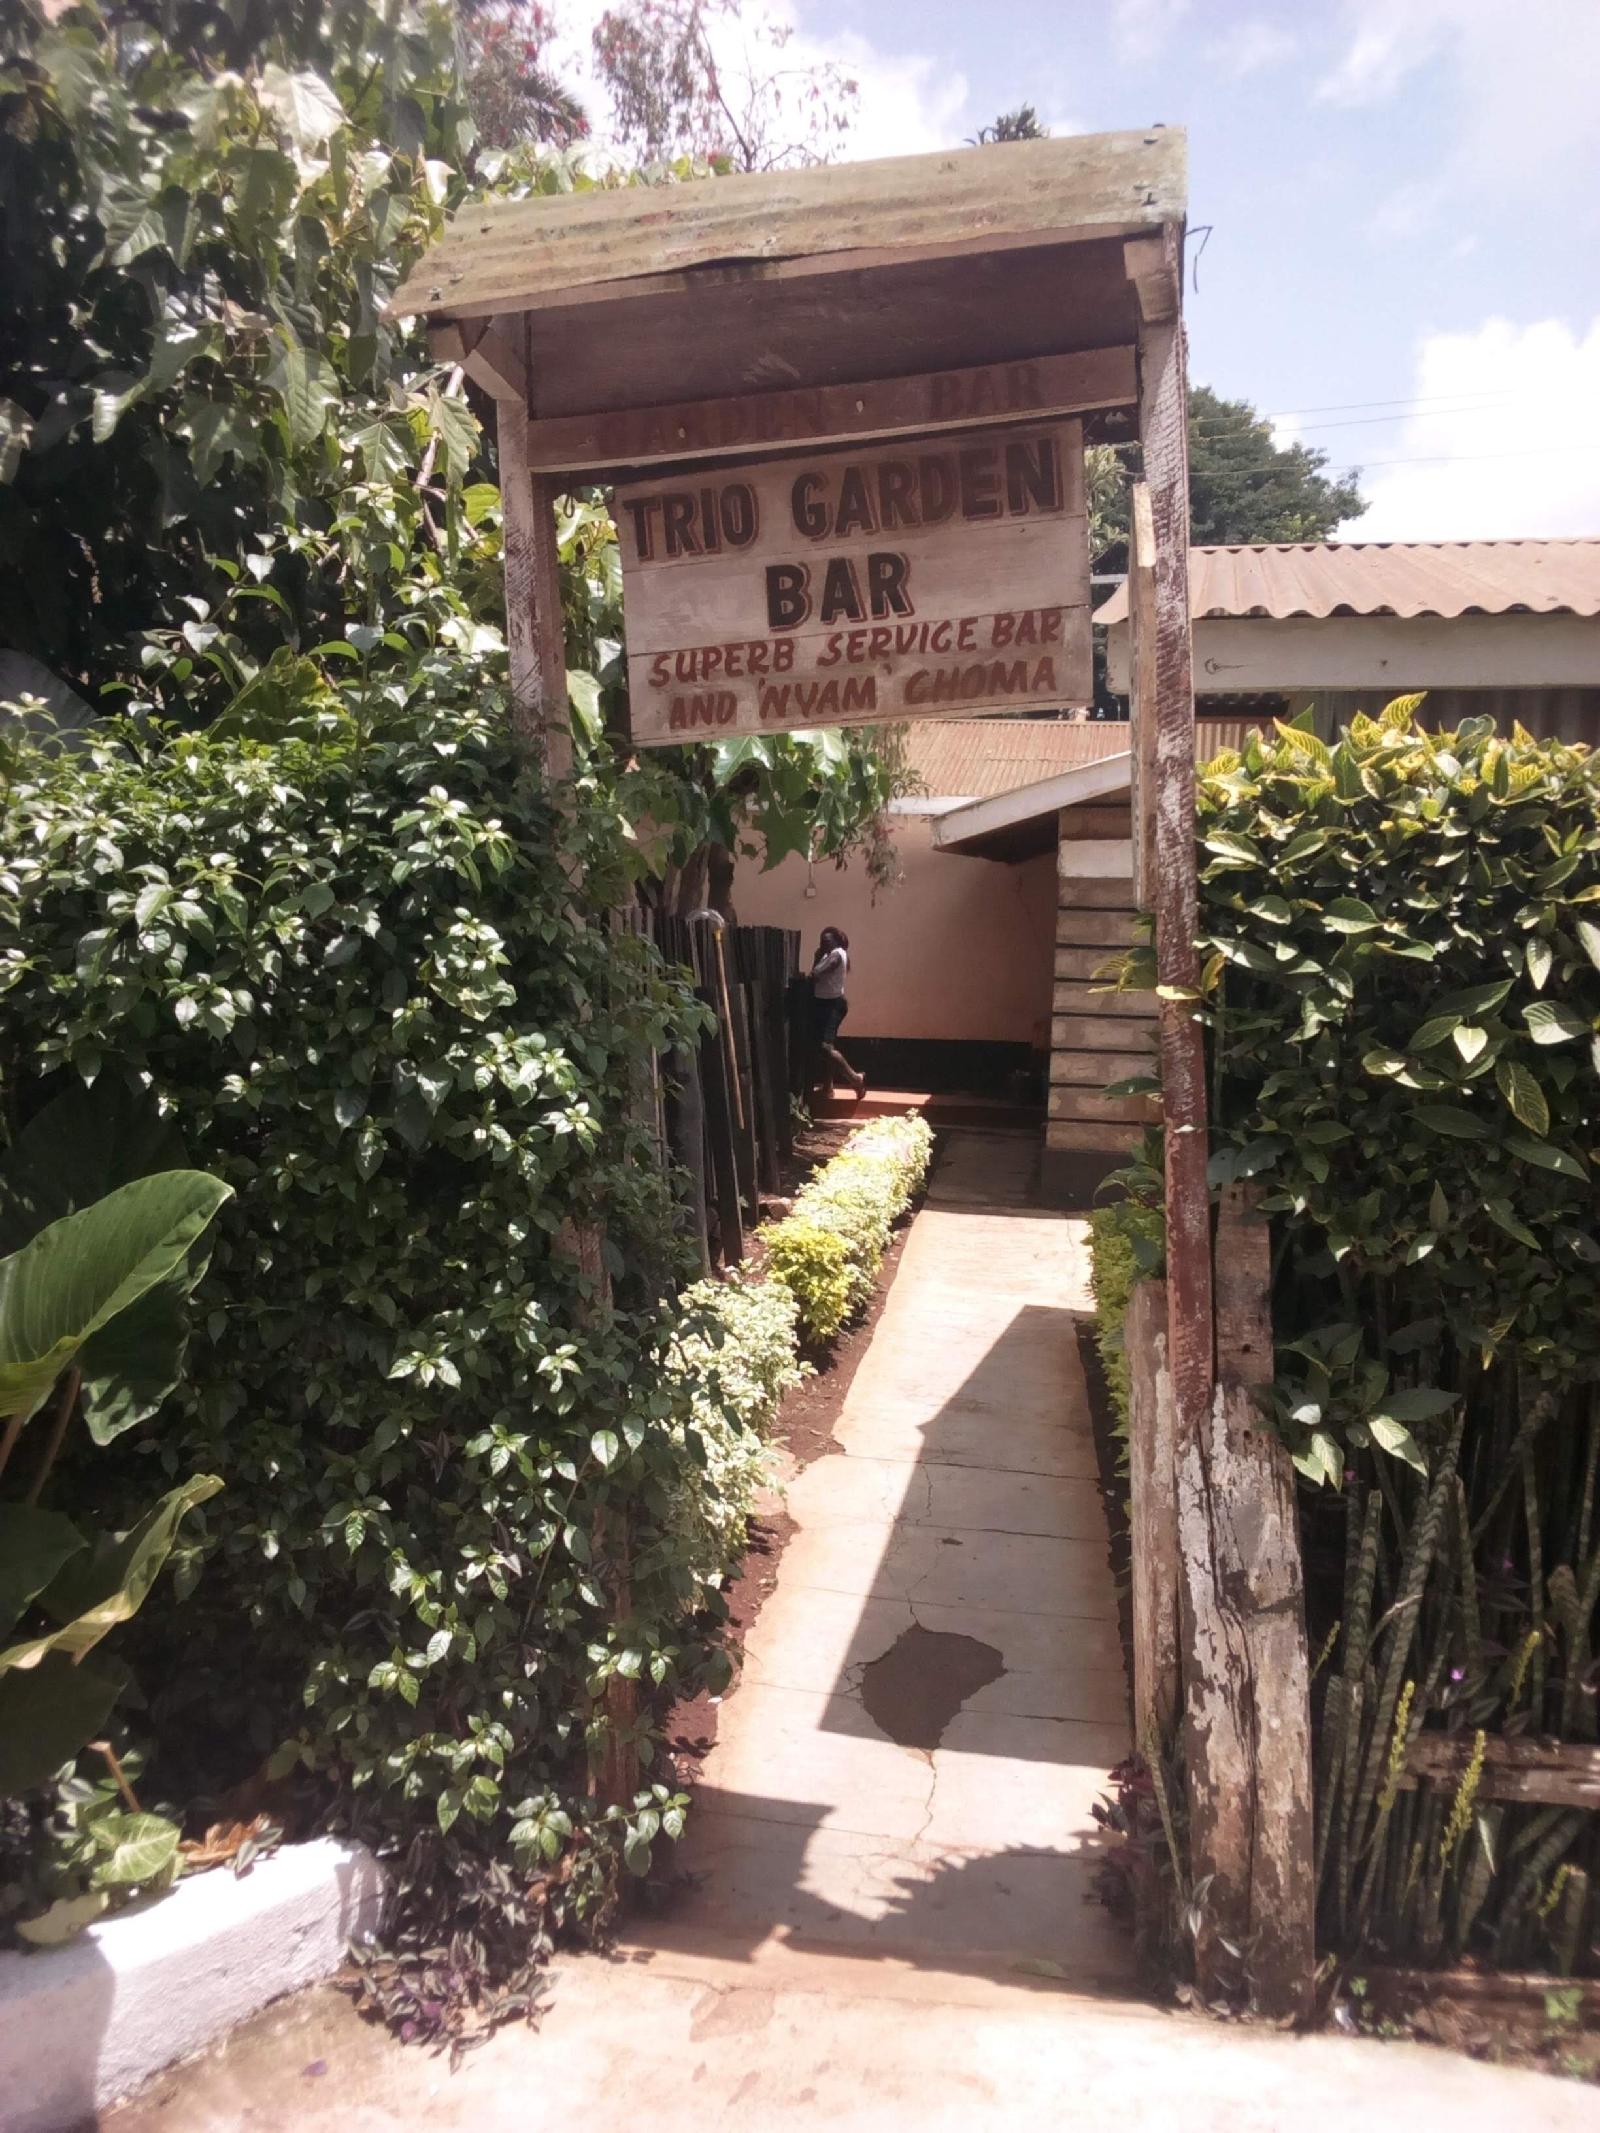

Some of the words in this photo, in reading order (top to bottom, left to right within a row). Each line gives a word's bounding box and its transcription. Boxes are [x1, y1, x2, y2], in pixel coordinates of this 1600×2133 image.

[622, 484, 759, 561] TRIO
[791, 438, 1064, 541] GARDEN
[766, 552, 914, 632] BAR
[649, 638, 794, 687] SUPERB
[816, 618, 978, 666] SERVICE
[991, 611, 1062, 648] BAR
[669, 691, 738, 730] AND
[904, 656, 1057, 704] CHOMA
